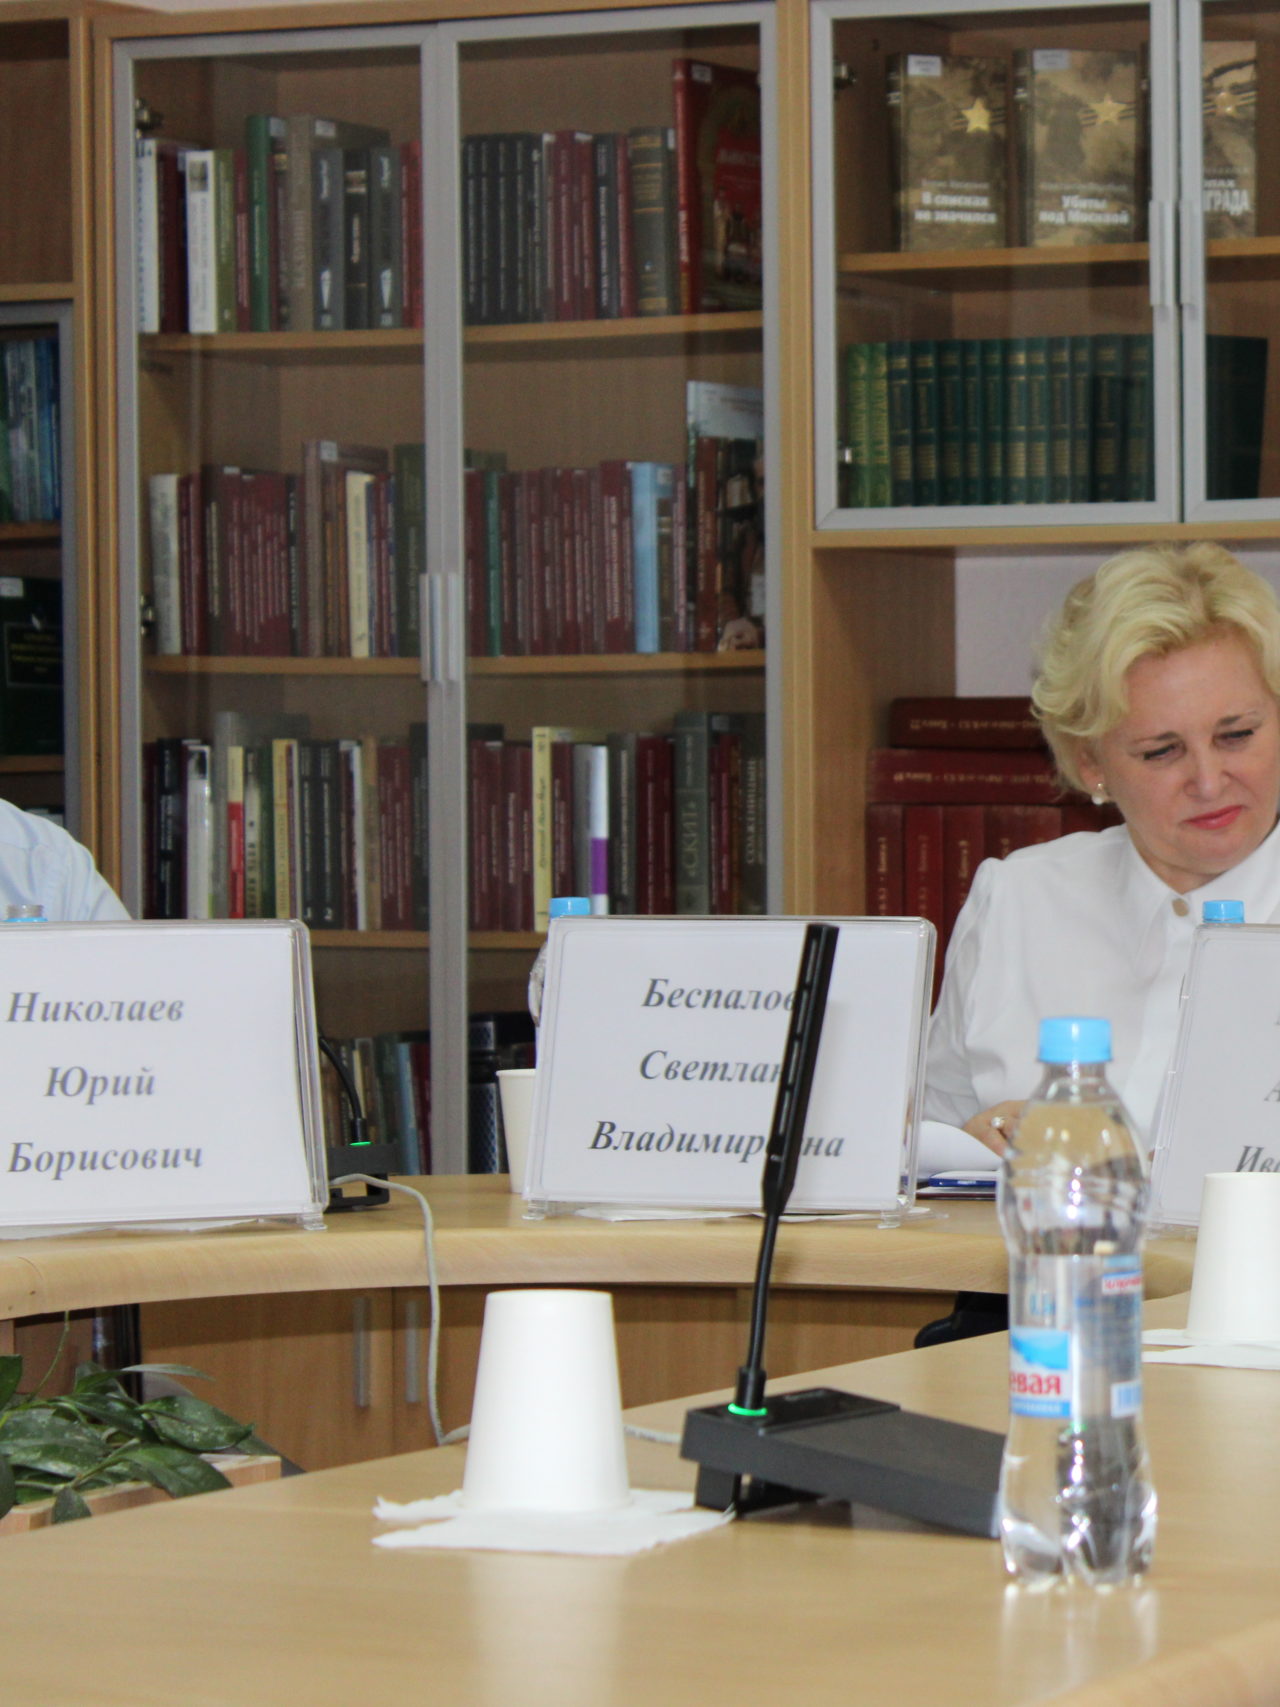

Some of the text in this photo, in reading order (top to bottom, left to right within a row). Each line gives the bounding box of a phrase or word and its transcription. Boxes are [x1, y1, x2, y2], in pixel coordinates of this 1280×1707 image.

[5, 991, 186, 1025] Николаев
[641, 977, 796, 1012] Беспалов
[638, 1049, 783, 1083] Светлан
[43, 1066, 157, 1105] Юрий
[587, 1120, 846, 1164] Владимирна
[8, 1141, 204, 1183] Борисович
[1009, 1372, 1062, 1396] евая
